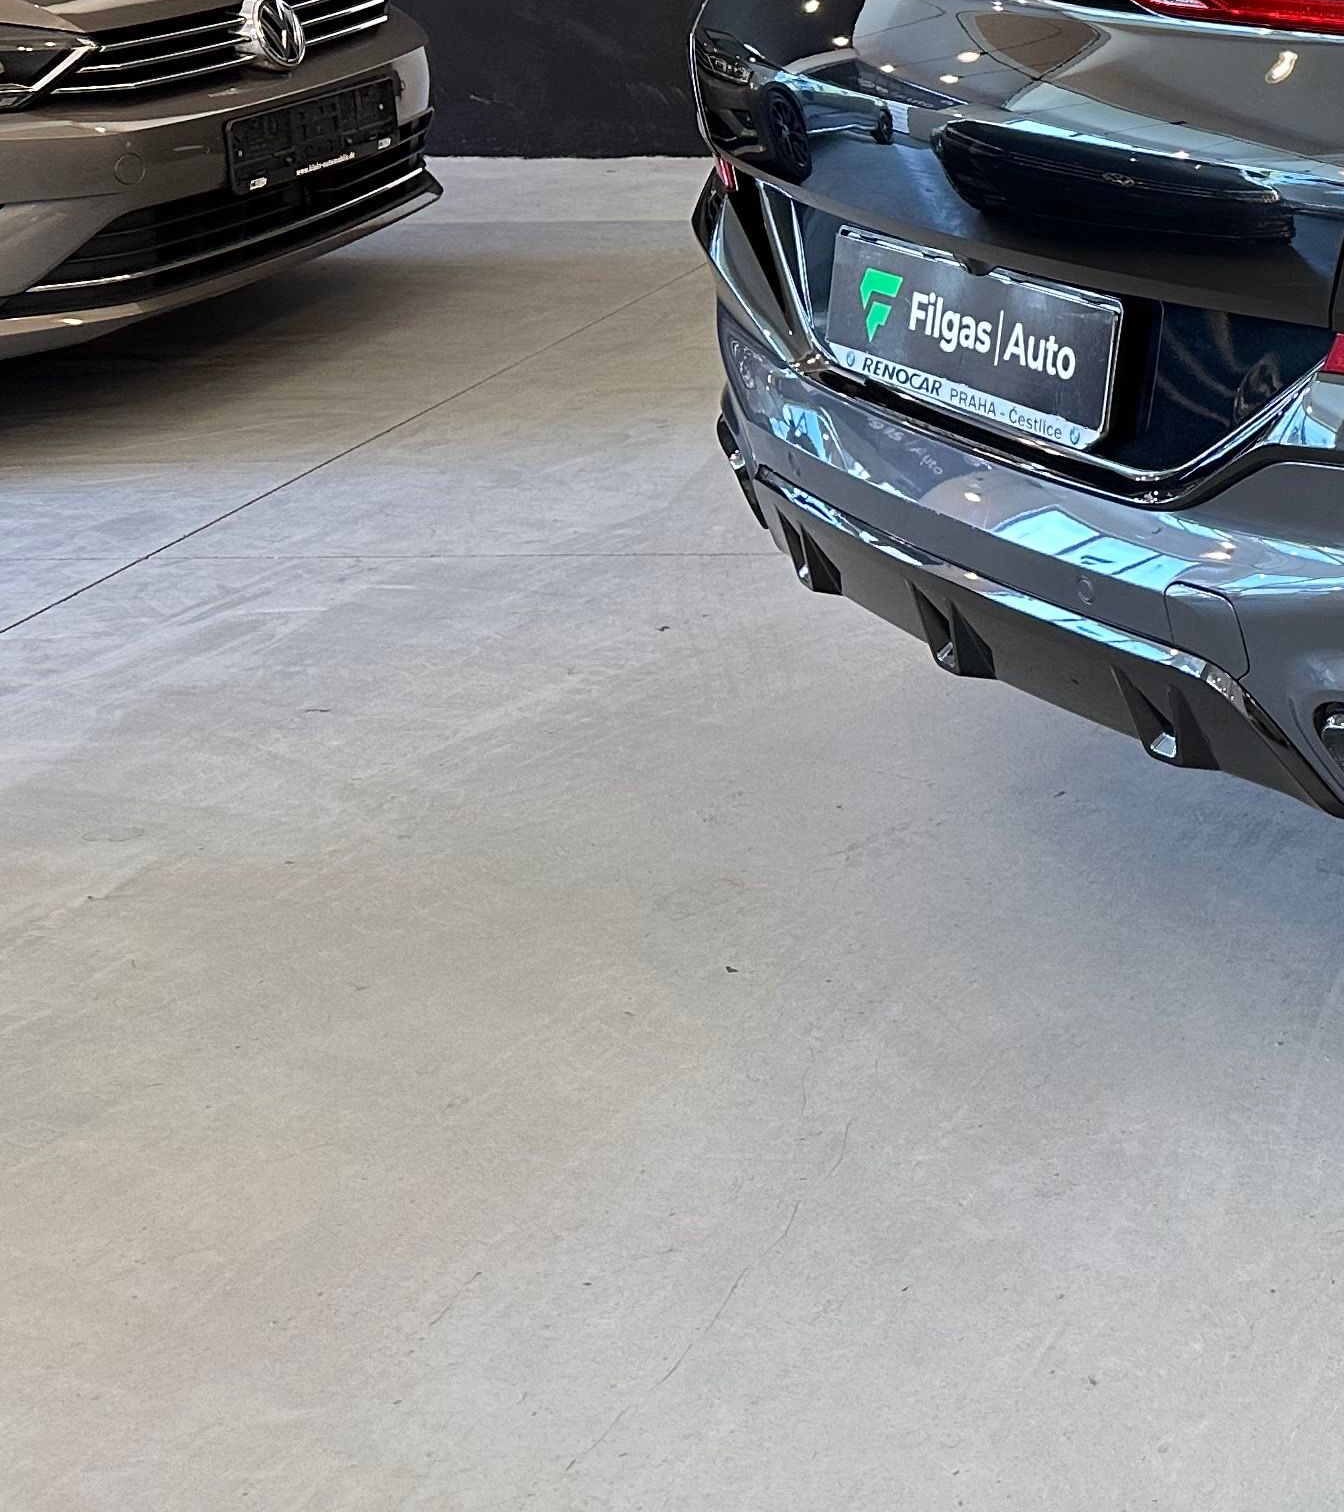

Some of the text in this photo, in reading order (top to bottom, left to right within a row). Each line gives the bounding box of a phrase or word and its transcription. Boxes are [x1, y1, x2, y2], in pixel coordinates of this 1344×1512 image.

[908, 291, 1076, 380] Filgas Auto
[862, 357, 943, 397] RENOCAR
[950, 388, 997, 417] PRAHA
[1008, 406, 1063, 440] Čestlice
